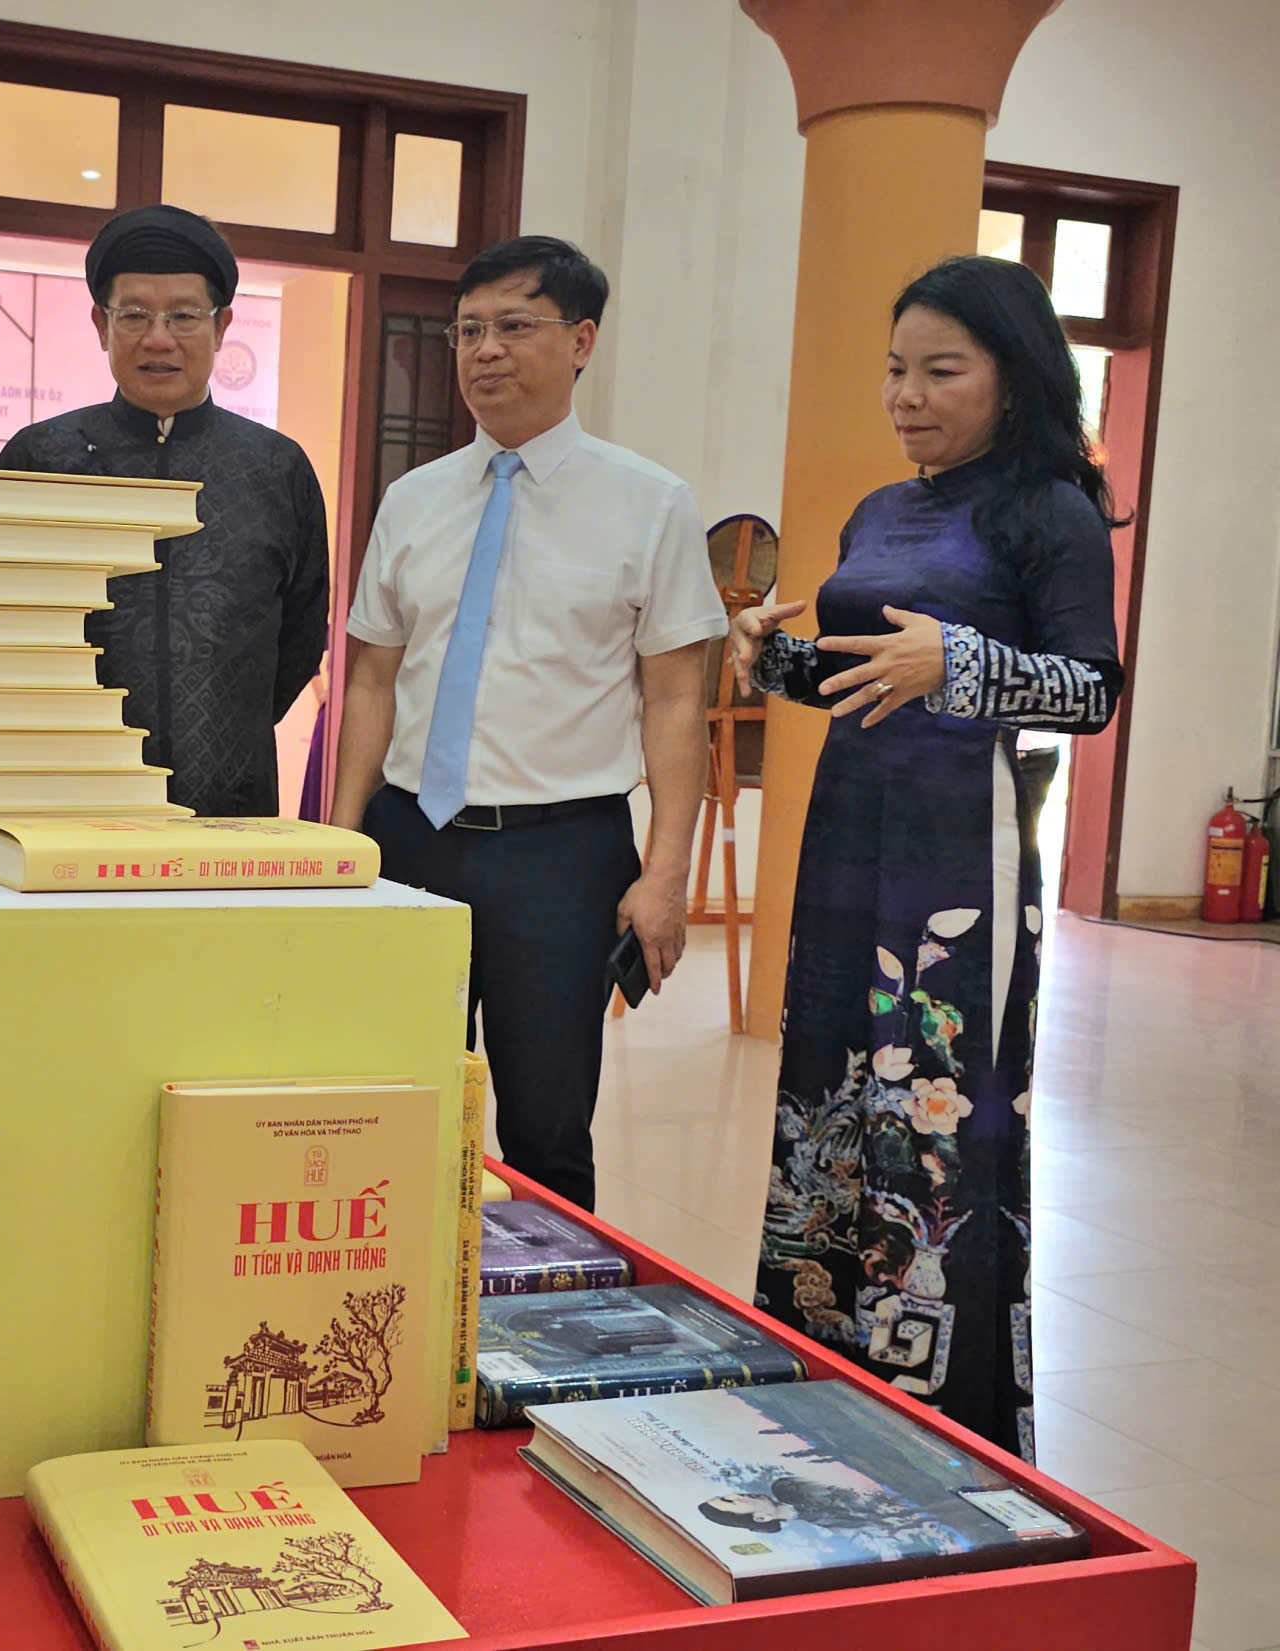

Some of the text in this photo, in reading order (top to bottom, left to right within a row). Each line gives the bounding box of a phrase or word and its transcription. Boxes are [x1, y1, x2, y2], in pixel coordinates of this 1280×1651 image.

[97, 857, 184, 878] HUẾ
[200, 861, 209, 877] DI
[214, 860, 237, 877] TÍCH
[241, 858, 254, 879] VÀ
[258, 861, 285, 879] DANH
[289, 857, 323, 877] THẮNG
[256, 1120, 266, 1128] ỦY
[284, 1119, 304, 1127] NHÂN
[306, 1118, 321, 1126] DÂN
[365, 1116, 379, 1124] HUẾ
[328, 1127, 341, 1135] THỂ
[234, 1180, 390, 1245] HUẾ
[234, 1242, 387, 1276] DI TÍCH VÀ DANH THẮNG
[130, 1481, 303, 1520] HUẾ
[141, 1512, 317, 1536] DI TÍCH VÀ DANH THẮNG
